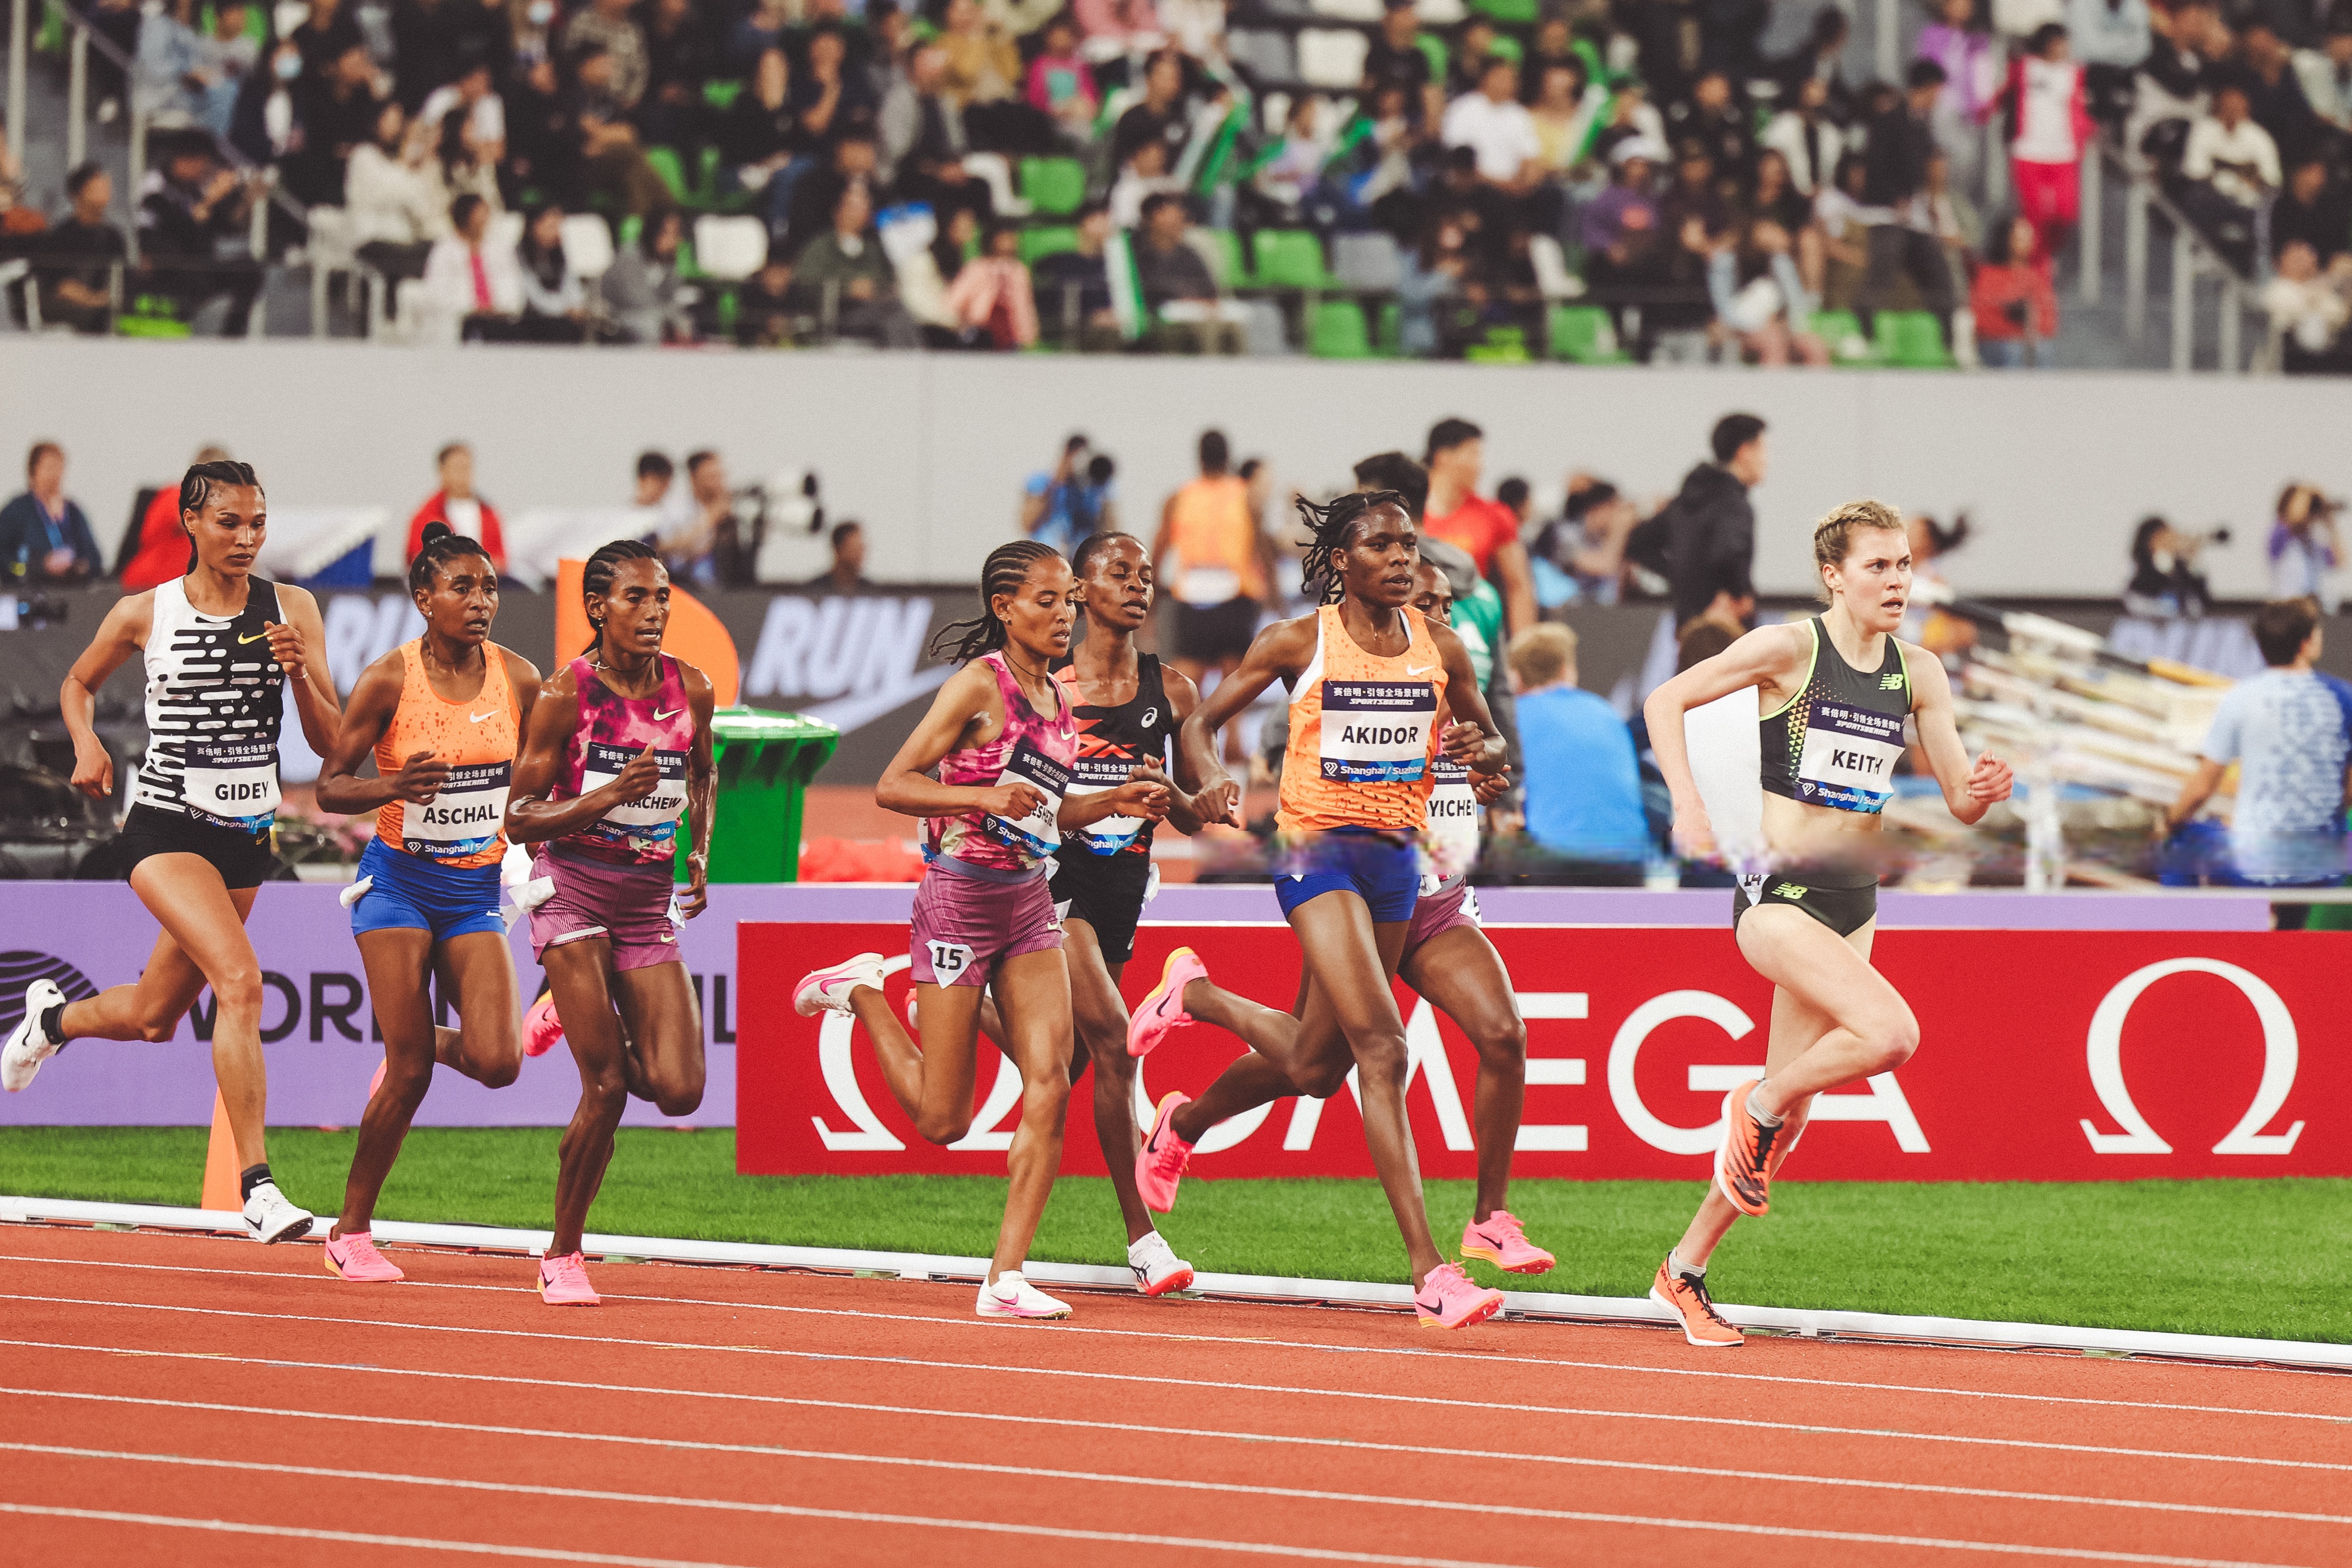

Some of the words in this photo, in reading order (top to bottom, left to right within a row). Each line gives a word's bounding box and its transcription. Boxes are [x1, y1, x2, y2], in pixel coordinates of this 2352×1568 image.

[325, 594, 428, 697] RU
[746, 595, 934, 698] RUN
[1341, 725, 1418, 744] AKIDOR
[1835, 720, 1891, 737] SPORTSBEAMS
[212, 754, 269, 764] SPORTSBEAMS
[1831, 748, 1884, 775] KEITH
[1078, 773, 1129, 781] SPORTSBEAM
[1340, 765, 1386, 775] Shanghai
[215, 781, 269, 800] GIDEY
[442, 778, 490, 789] ORTSBEAMS
[1817, 787, 1859, 804] Shanghai
[422, 804, 499, 825] ASCHAL
[1425, 800, 1475, 817] YICHE
[425, 844, 469, 855] Shanghai
[935, 946, 964, 970] 15
